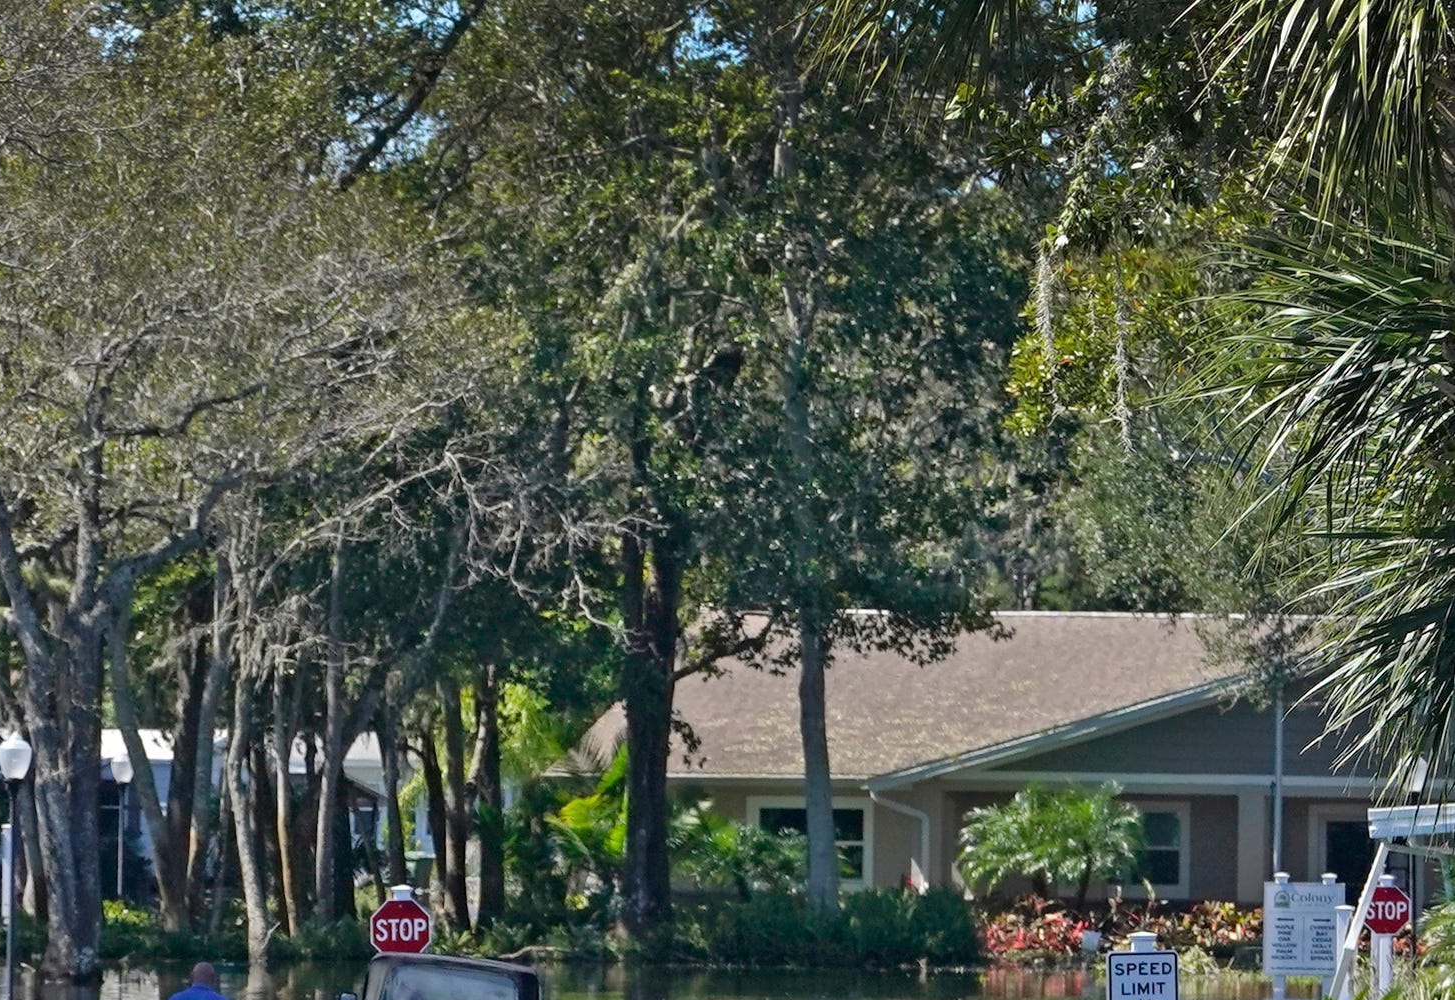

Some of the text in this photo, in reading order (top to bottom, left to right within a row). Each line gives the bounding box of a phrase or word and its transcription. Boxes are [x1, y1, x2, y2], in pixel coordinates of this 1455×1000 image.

[1291, 892, 1335, 905] Colony
[1365, 900, 1408, 921] STOP
[375, 918, 428, 942] STOP
[1114, 962, 1173, 976] SPEED
[1121, 982, 1166, 995] LIMIT
